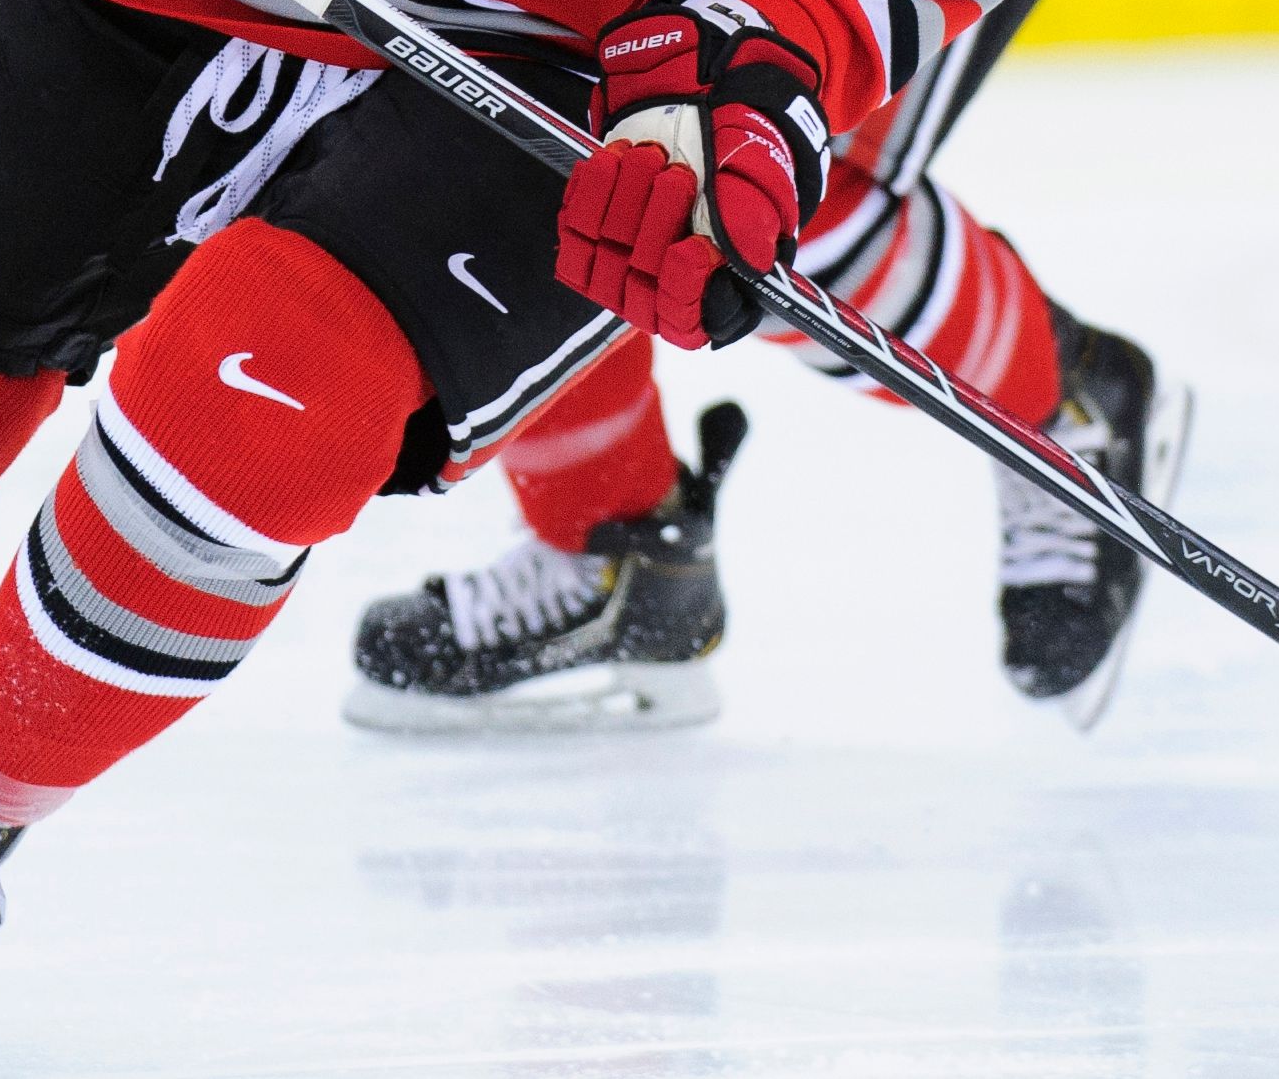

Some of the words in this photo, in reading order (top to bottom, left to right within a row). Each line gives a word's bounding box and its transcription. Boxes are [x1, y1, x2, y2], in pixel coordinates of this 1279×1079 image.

[383, 34, 508, 119] BAUER
[604, 30, 683, 60] BAUER
[1181, 537, 1278, 618] VAPOR
